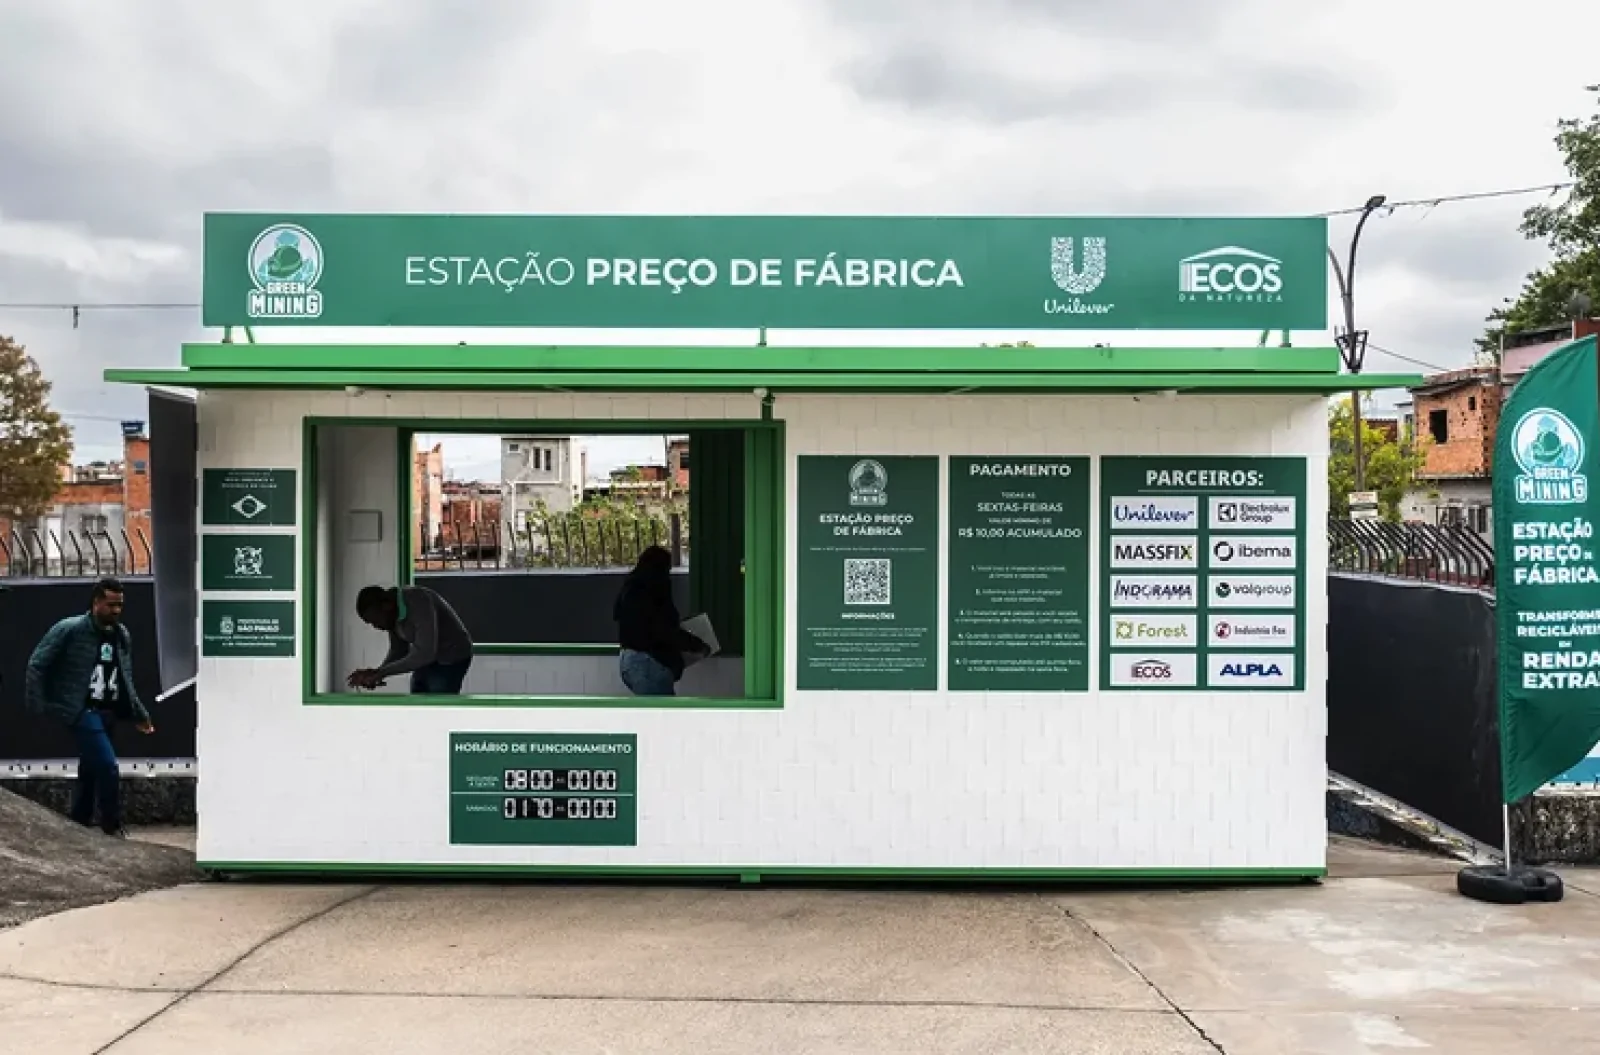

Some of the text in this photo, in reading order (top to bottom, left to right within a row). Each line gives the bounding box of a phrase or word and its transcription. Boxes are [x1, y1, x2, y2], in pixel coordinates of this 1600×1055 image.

[405, 252, 964, 293] ESTAÇÃO PREÇO DE FÁBRICA
[1181, 262, 1283, 292] ECOS
[267, 282, 306, 294] GREEN
[252, 294, 319, 314] MINING
[1044, 297, 1115, 314] Unilever
[969, 463, 1072, 477] PAGAMENTO
[1533, 467, 1570, 479] GREEN
[1146, 470, 1264, 486] PARCEIROS:
[1518, 478, 1585, 500] MINING
[977, 502, 1063, 512] SEXTAS-FEIRAS
[1114, 503, 1194, 522] Unilever
[819, 512, 914, 524] ESTAÇÃO PREÇO
[833, 524, 903, 535] DE FÁBRICA
[1005, 528, 1083, 538] ACUMULADO
[1512, 517, 1594, 543] ESTAÇÃO
[1115, 544, 1192, 560] MASSFIX
[1239, 544, 1291, 558] ibema
[1514, 543, 1582, 566] PREÇO
[1513, 562, 1600, 584] FÁBRICA
[1137, 624, 1188, 638] Forest
[1516, 622, 1600, 637] RECICLÁVEI
[1523, 649, 1600, 670] RENDA
[1220, 664, 1283, 676] ALPLA
[455, 740, 632, 754] HORÁRIO DE FUNCIONAMENTO
